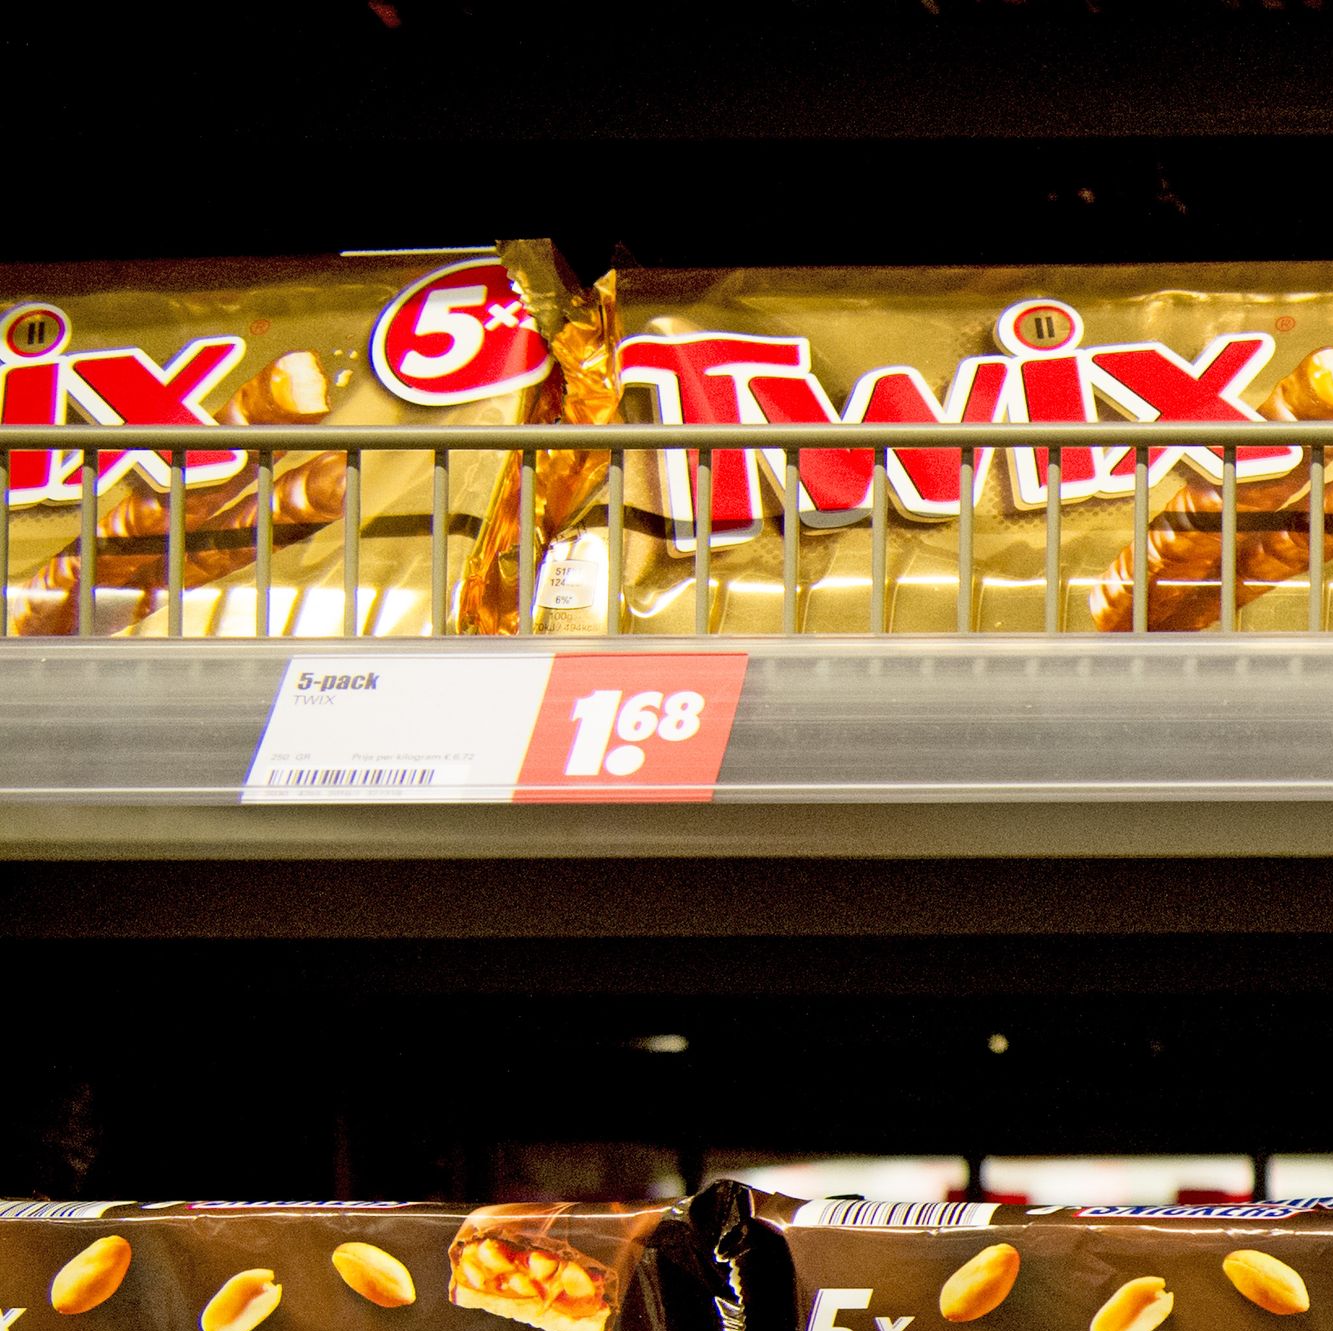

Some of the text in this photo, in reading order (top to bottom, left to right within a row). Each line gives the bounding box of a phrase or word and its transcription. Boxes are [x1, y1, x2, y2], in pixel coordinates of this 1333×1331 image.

[401, 285, 536, 378] 5x
[293, 695, 337, 705] TWIX
[296, 672, 380, 692] 5-pack
[570, 689, 705, 777] 1.68
